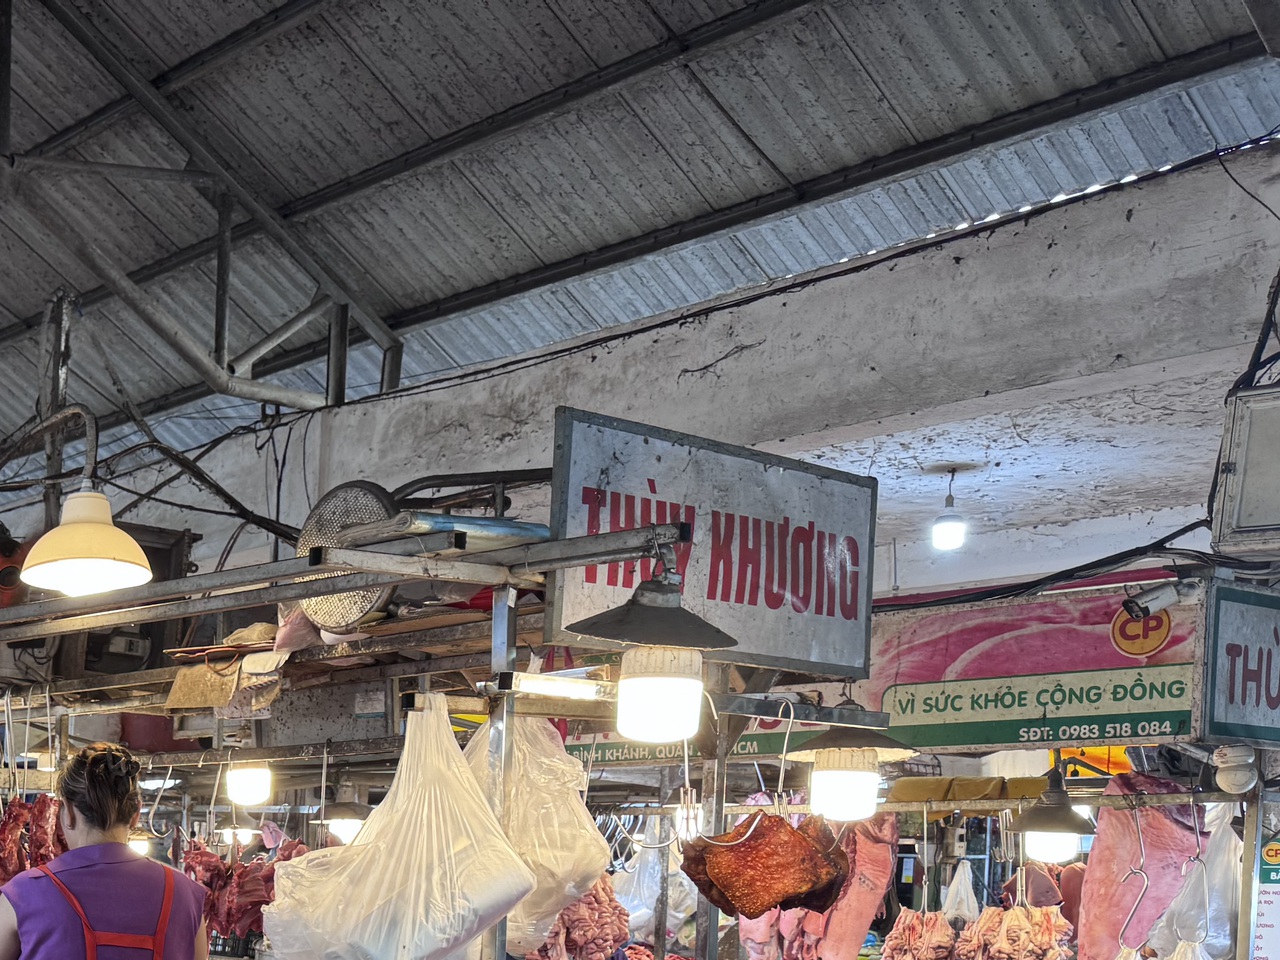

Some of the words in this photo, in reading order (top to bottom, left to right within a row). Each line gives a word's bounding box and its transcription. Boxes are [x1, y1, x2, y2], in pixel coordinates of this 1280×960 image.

[706, 509, 860, 621] KHƯƠNG
[1118, 615, 1164, 641] CP
[898, 691, 915, 714] VÌ
[922, 690, 963, 713] SỨC
[970, 685, 1028, 711] KHỎE
[1036, 683, 1102, 711] CỘNG
[1111, 672, 1186, 702] ĐỒNG
[1019, 726, 1053, 742] SĐT:
[1058, 724, 1099, 740] 0983
[1105, 722, 1131, 737] 518
[1137, 720, 1171, 736] 084
[605, 744, 651, 760] KHÁNH,
